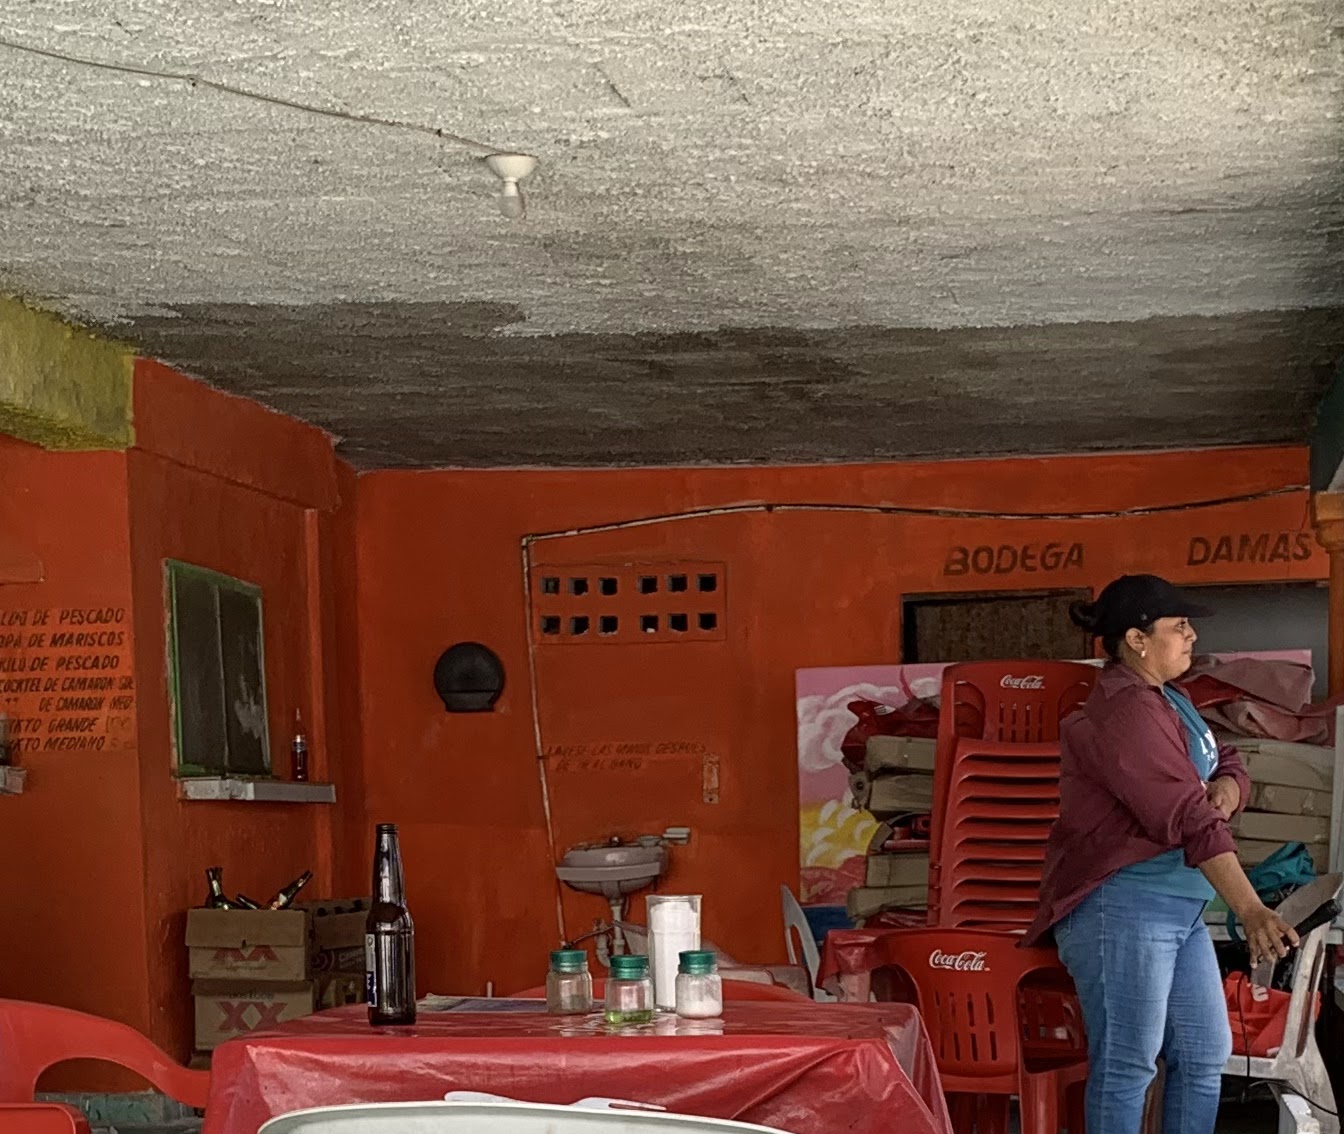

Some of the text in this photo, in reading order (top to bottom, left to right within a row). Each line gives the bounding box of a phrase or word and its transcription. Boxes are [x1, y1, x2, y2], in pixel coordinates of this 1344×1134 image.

[943, 532, 1314, 577] BODEGA DAMAS
[32, 609, 50, 626] DE
[59, 608, 125, 625] PESCADO
[28, 633, 47, 648] DE
[49, 631, 125, 648] MARISCOS
[30, 657, 50, 671] DE
[56, 655, 120, 671] PESCADO
[43, 677, 58, 692] DE
[61, 677, 113, 692] CAMARON
[1000, 674, 1045, 690] Coca-Cola
[39, 697, 54, 712] DE
[56, 697, 106, 712] CAMARON
[48, 717, 100, 733] GRANDE
[44, 736, 106, 752] MEDIANO
[929, 949, 988, 971] Coca-Cola
[216, 1001, 288, 1031] XX
